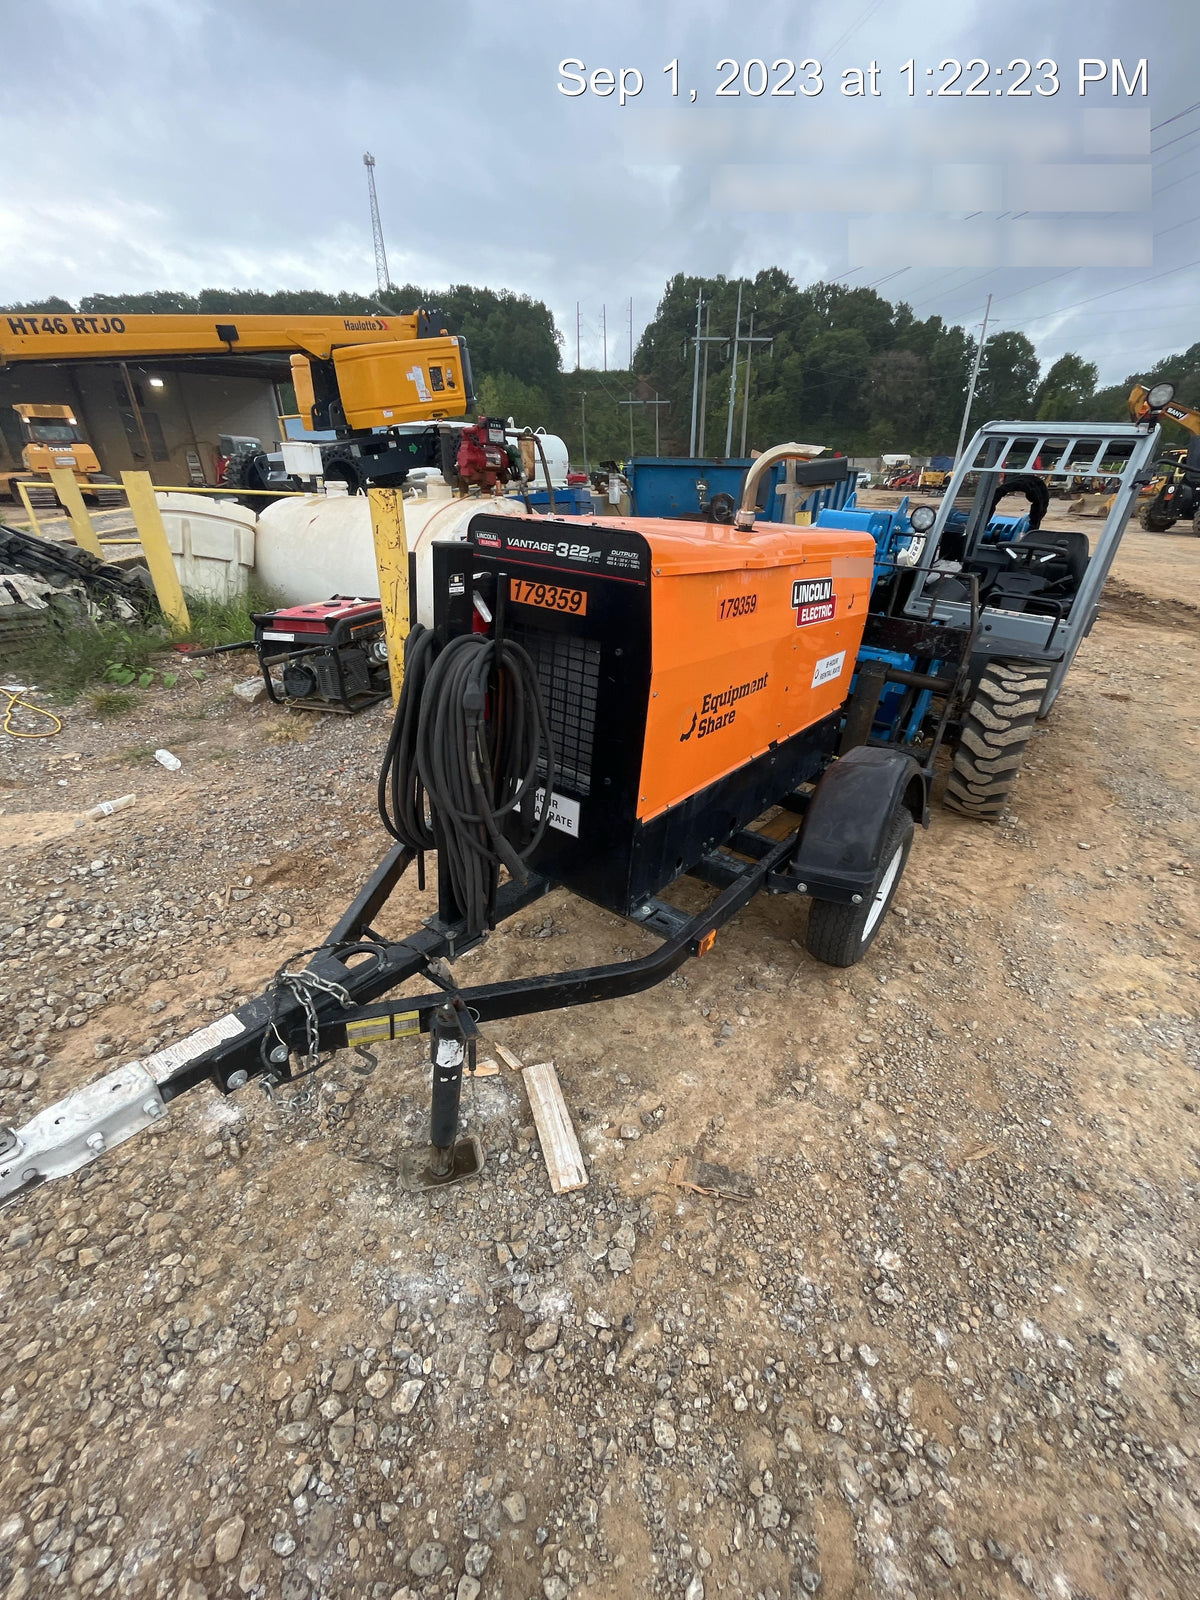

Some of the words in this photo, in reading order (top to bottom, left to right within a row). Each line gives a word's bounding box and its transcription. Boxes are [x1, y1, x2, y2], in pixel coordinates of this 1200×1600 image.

[7, 317, 68, 335] HT46
[71, 317, 126, 334] RTJO
[343, 319, 377, 331] Haulotte
[476, 532, 497, 541] LINCOLN
[507, 537, 555, 552] VANTAGE
[555, 542, 590, 558] 322
[514, 581, 583, 612] 179359
[794, 584, 831, 604] LINCOLN
[720, 594, 758, 620] 179359
[802, 603, 832, 622] ELECTRIC
[701, 672, 768, 714] Equipment
[697, 709, 736, 739] Share
[549, 811, 572, 827] RATE
